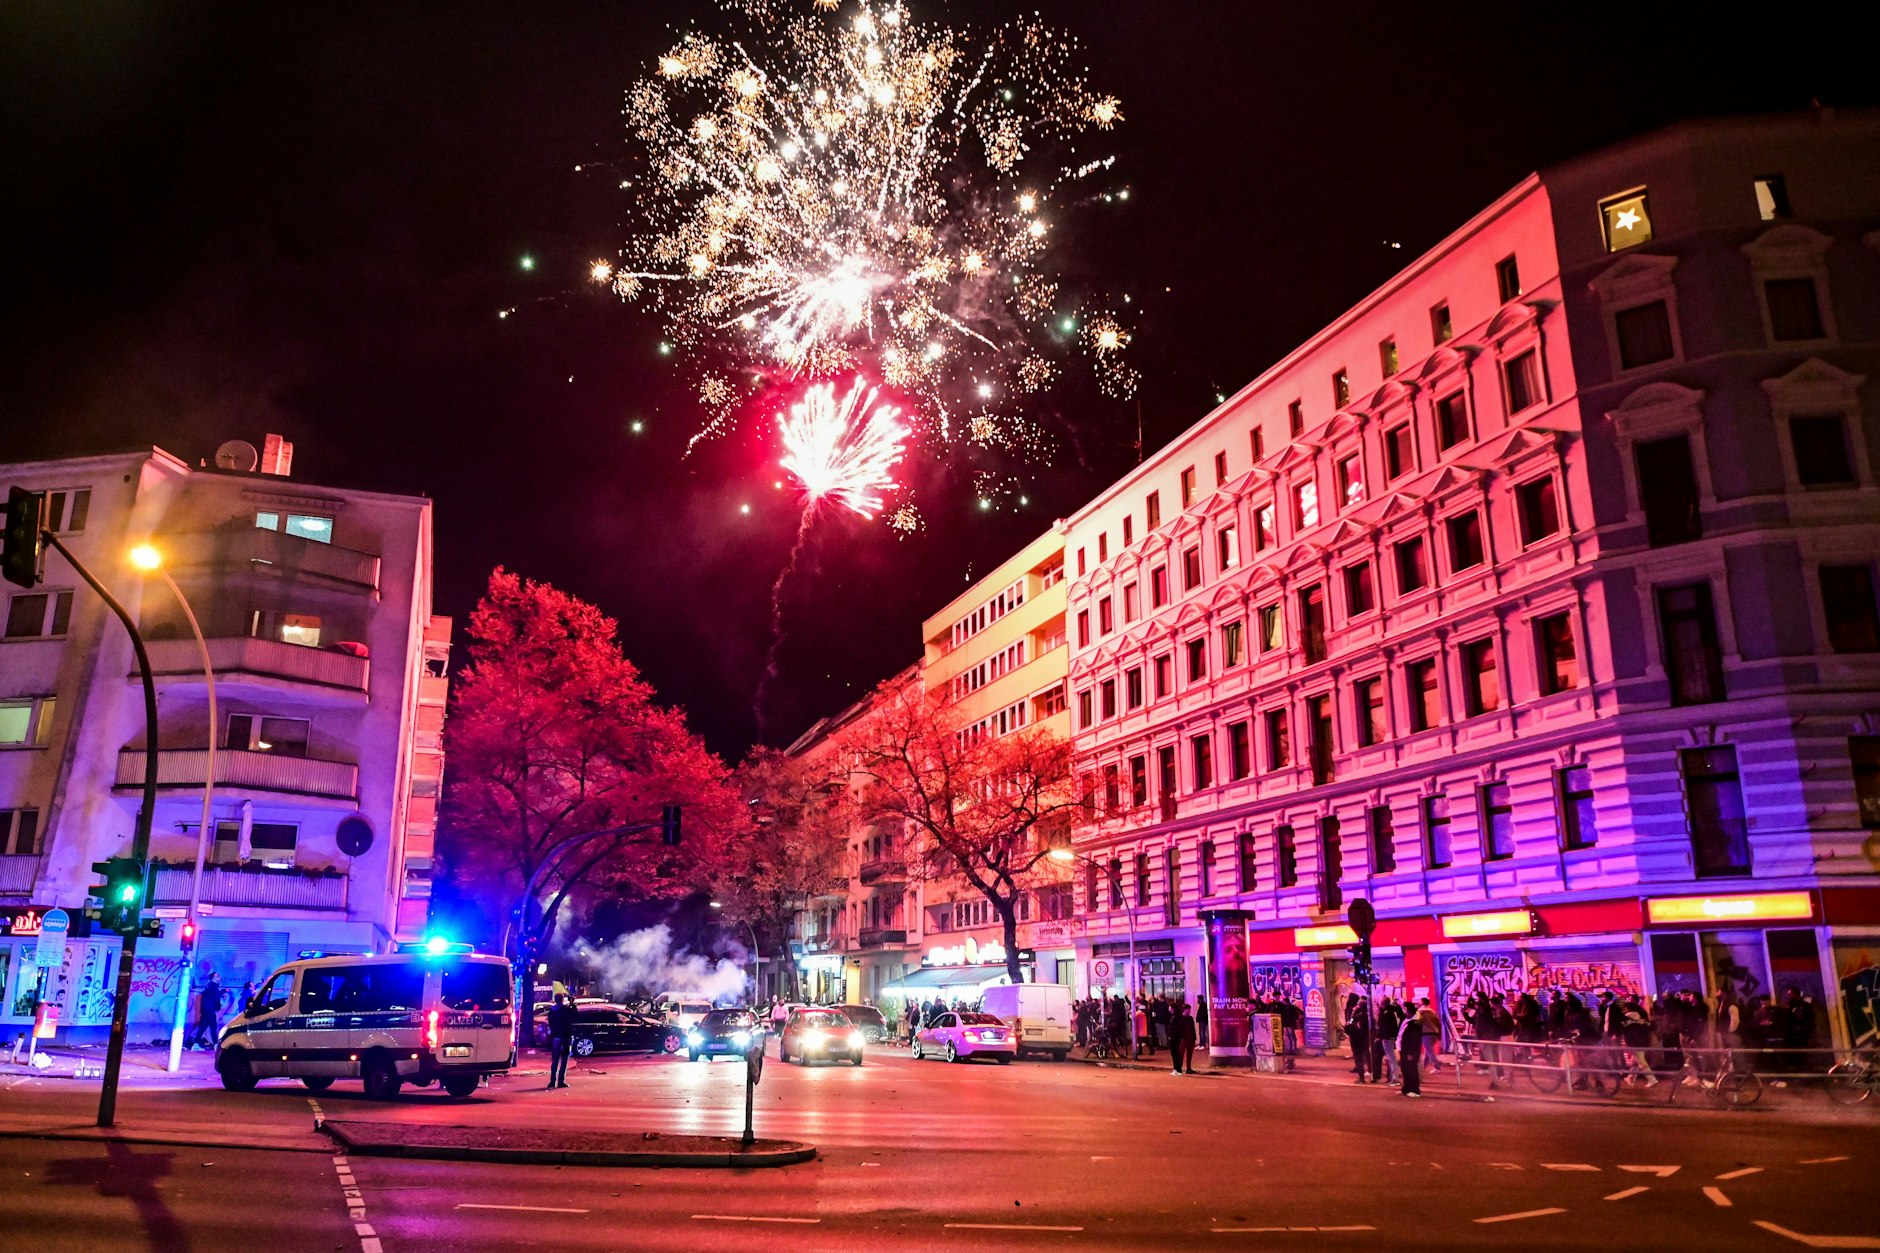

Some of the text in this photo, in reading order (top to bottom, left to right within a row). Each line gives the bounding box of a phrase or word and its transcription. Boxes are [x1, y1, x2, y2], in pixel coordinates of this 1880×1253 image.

[1097, 964, 1107, 973] 30
[1530, 963, 1570, 988] THE
[305, 1017, 335, 1029] POLIZEI
[442, 1015, 474, 1026] POLIZEI
